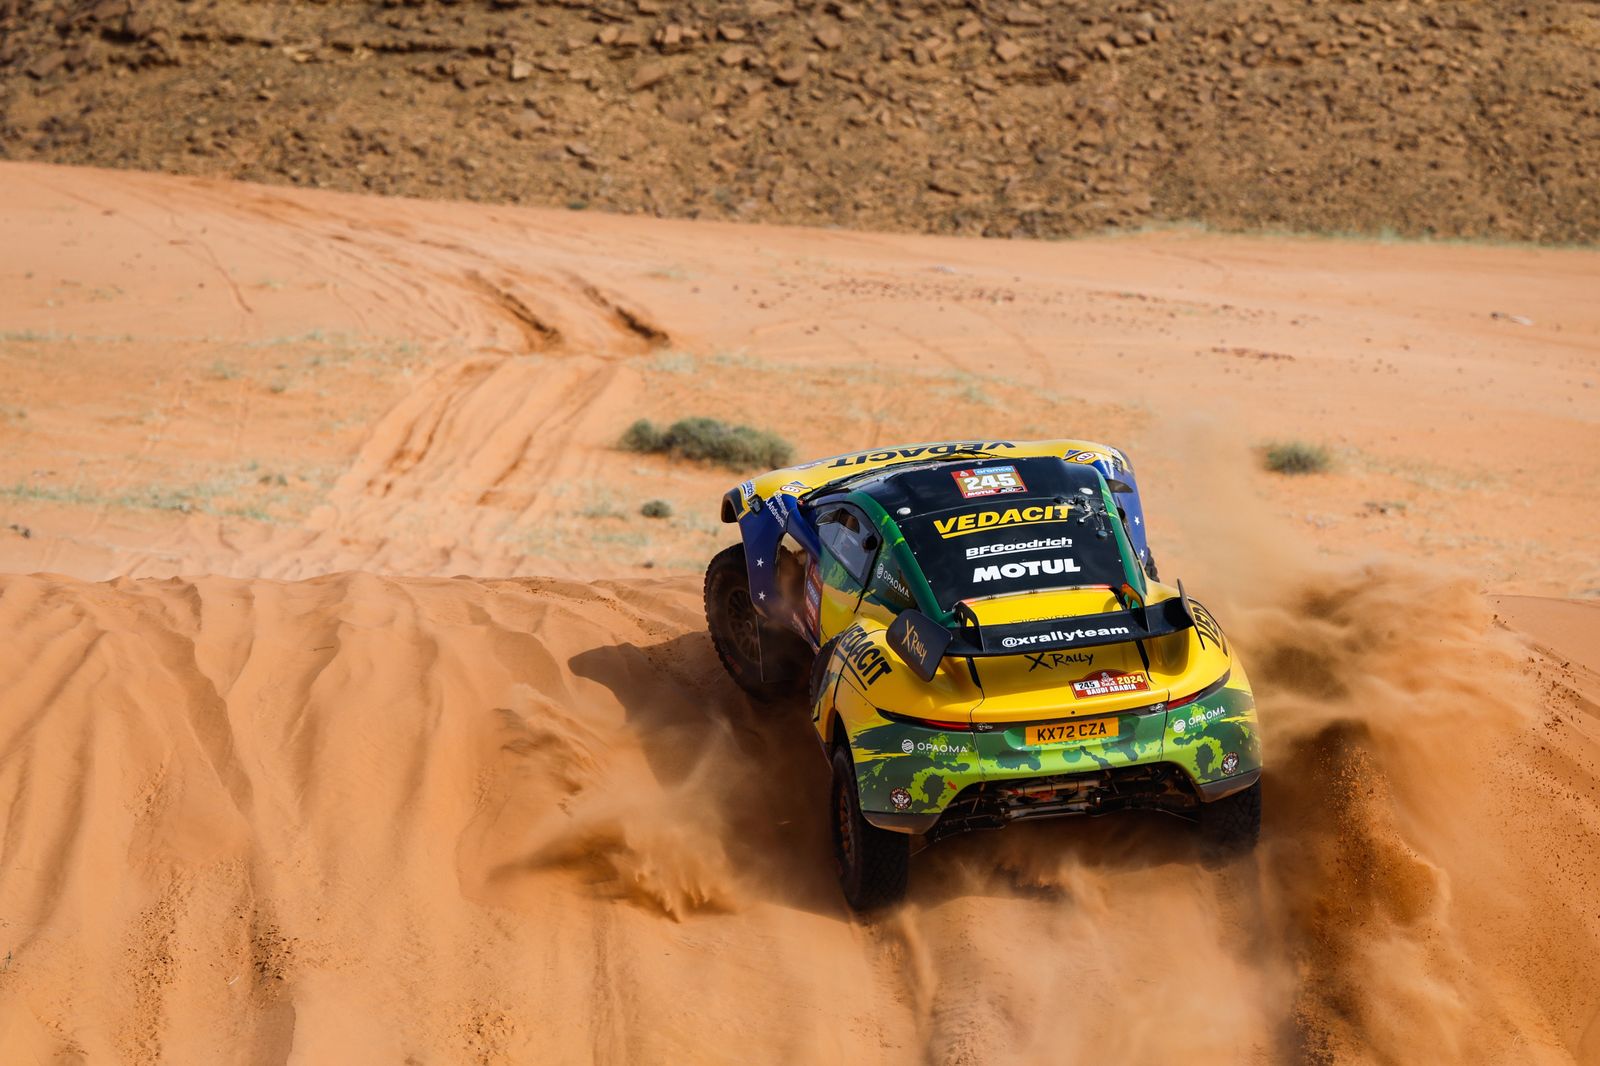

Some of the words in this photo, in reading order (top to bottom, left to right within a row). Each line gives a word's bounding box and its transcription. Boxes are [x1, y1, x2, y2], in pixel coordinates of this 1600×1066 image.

[828, 442, 1016, 469] VEDACIT
[964, 473, 1017, 491] 245
[933, 504, 1074, 536] VEDACIT
[966, 537, 1073, 558] BFGoodrich
[973, 558, 1081, 583] MOTUL
[883, 570, 910, 599] OPAOMA
[1002, 626, 1130, 648] @xrallyteam
[838, 622, 893, 686] VEDACIT
[1024, 652, 1054, 673] X
[1078, 682, 1096, 690] 245
[1117, 675, 1144, 685] 2024
[1086, 687, 1109, 696] SAUDI
[1109, 684, 1137, 694] ARABIA
[1188, 705, 1226, 726] OPAOMA
[1037, 725, 1075, 742] KX72
[1078, 723, 1107, 738] CZA
[917, 742, 968, 754] OPAOMA
